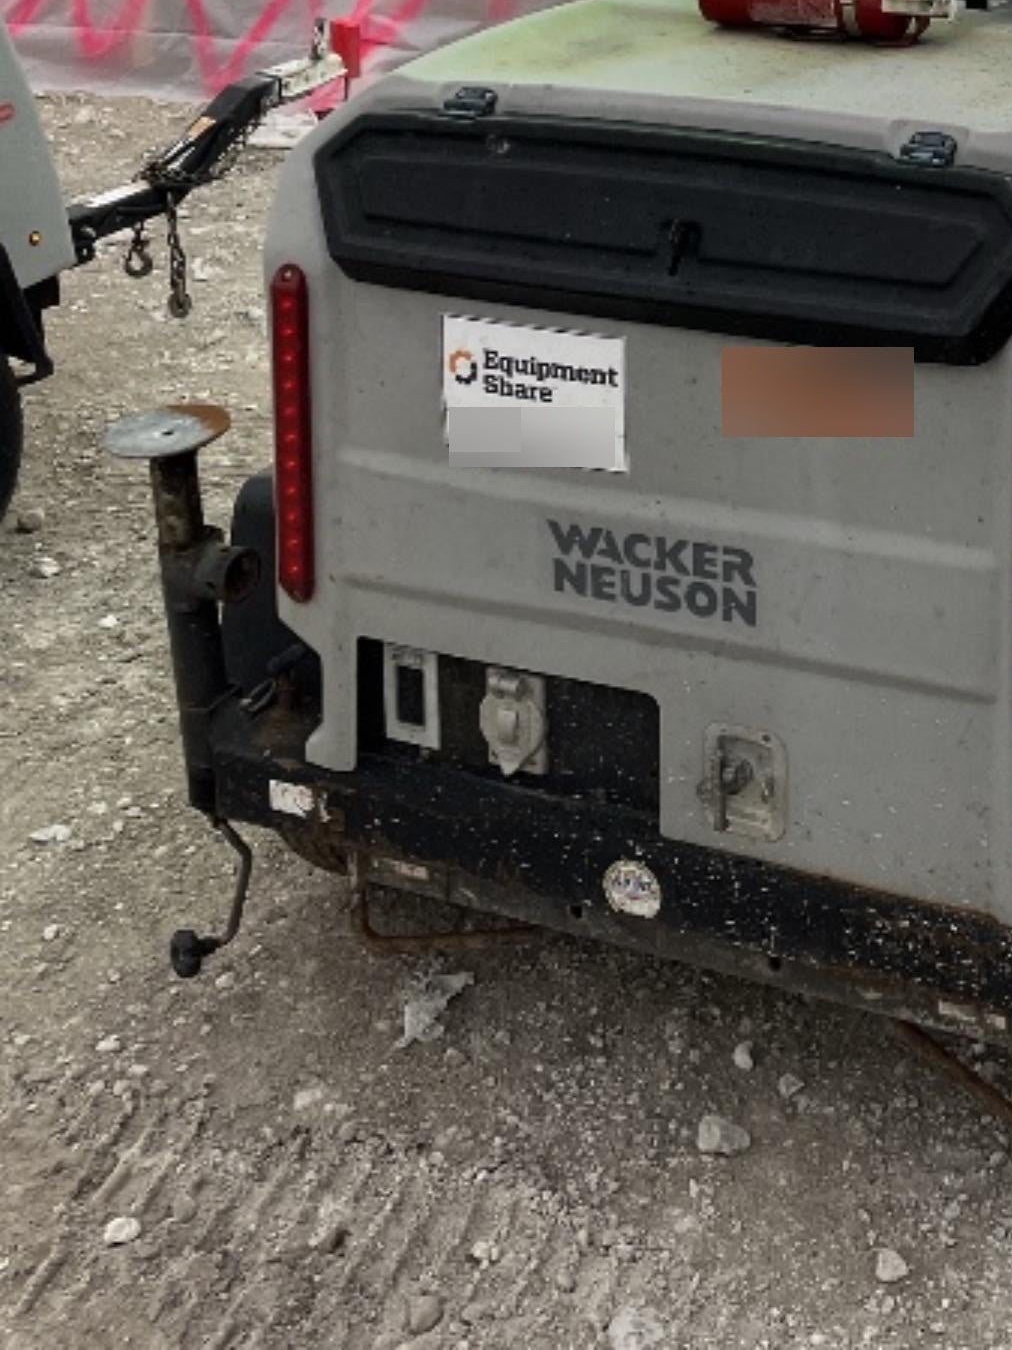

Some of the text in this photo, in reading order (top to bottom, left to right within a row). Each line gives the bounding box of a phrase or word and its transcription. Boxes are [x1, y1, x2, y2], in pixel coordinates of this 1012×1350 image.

[483, 348, 618, 387] Equipment
[483, 374, 554, 403] Share
[546, 518, 757, 588] WACKER
[553, 558, 757, 627] NEUSON
